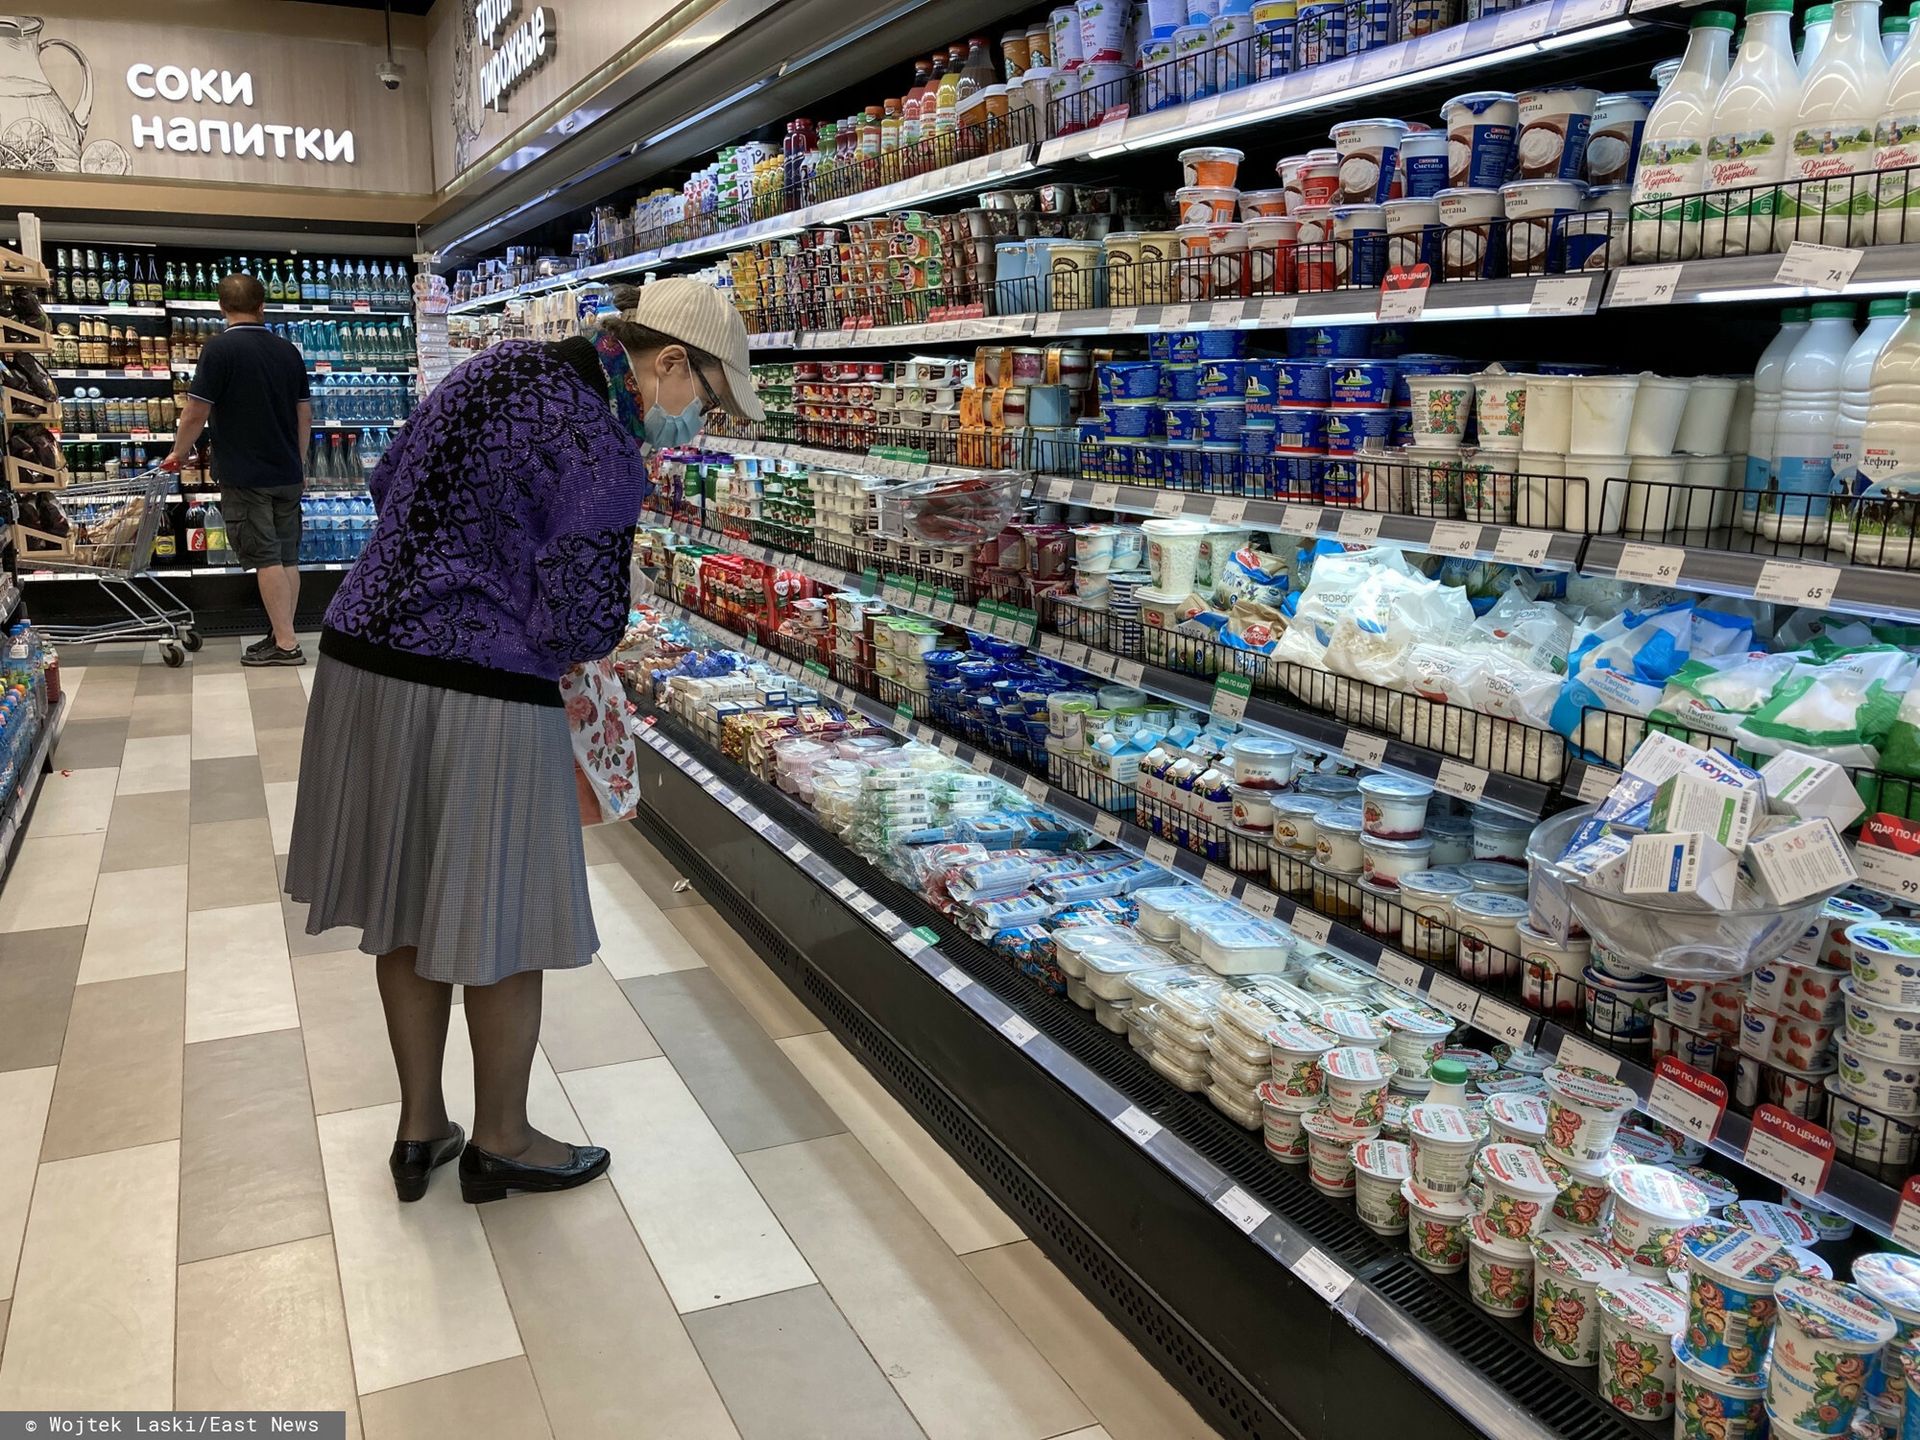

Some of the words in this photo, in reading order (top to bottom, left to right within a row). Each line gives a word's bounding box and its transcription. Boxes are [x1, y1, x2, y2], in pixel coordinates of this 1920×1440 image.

[480, 6, 546, 112] пирожные
[126, 63, 254, 106] соки
[131, 114, 354, 163] напитки
[1875, 147, 1906, 166] Домик
[1712, 160, 1745, 177] Домик
[1801, 157, 1842, 174] Домик
[1642, 167, 1673, 180] Домик
[1721, 166, 1759, 185] деревне
[1642, 192, 1672, 200] КЕФИР
[1826, 269, 1842, 282] 74
[1654, 285, 1667, 296] 79
[1567, 296, 1579, 306] 42
[1863, 455, 1899, 469] Кефир
[1364, 527, 1373, 536] 97
[1459, 540, 1470, 550] 60
[1529, 549, 1539, 558] 48
[1657, 565, 1670, 576] 56
[1318, 593, 1353, 604] ТВОРОГ
[1807, 587, 1822, 599] 65
[1603, 674, 1631, 692] Творог
[1588, 677, 1640, 706] рассыпчатый
[1687, 705, 1716, 722] Творог
[1369, 752, 1378, 761] 99
[1463, 781, 1476, 793] 109
[1869, 821, 1894, 834] УДАР
[1895, 828, 1910, 839] ПО
[1901, 880, 1918, 893] 99
[1315, 931, 1323, 940] 76
[1404, 977, 1413, 987] 62
[1457, 1002, 1468, 1012] 62
[1506, 1026, 1517, 1037] 62
[1661, 1063, 1681, 1076] УДАР
[1681, 1071, 1694, 1083] ПО
[1694, 1076, 1725, 1098] ЦЕНАМ!
[1689, 1116, 1702, 1130] 44
[1760, 1110, 1782, 1125] УДАР
[1783, 1120, 1796, 1132] ПО
[1797, 1128, 1832, 1150] ЦЕНАМ!
[1791, 1172, 1806, 1186] 44
[1324, 1282, 1336, 1293] 28
